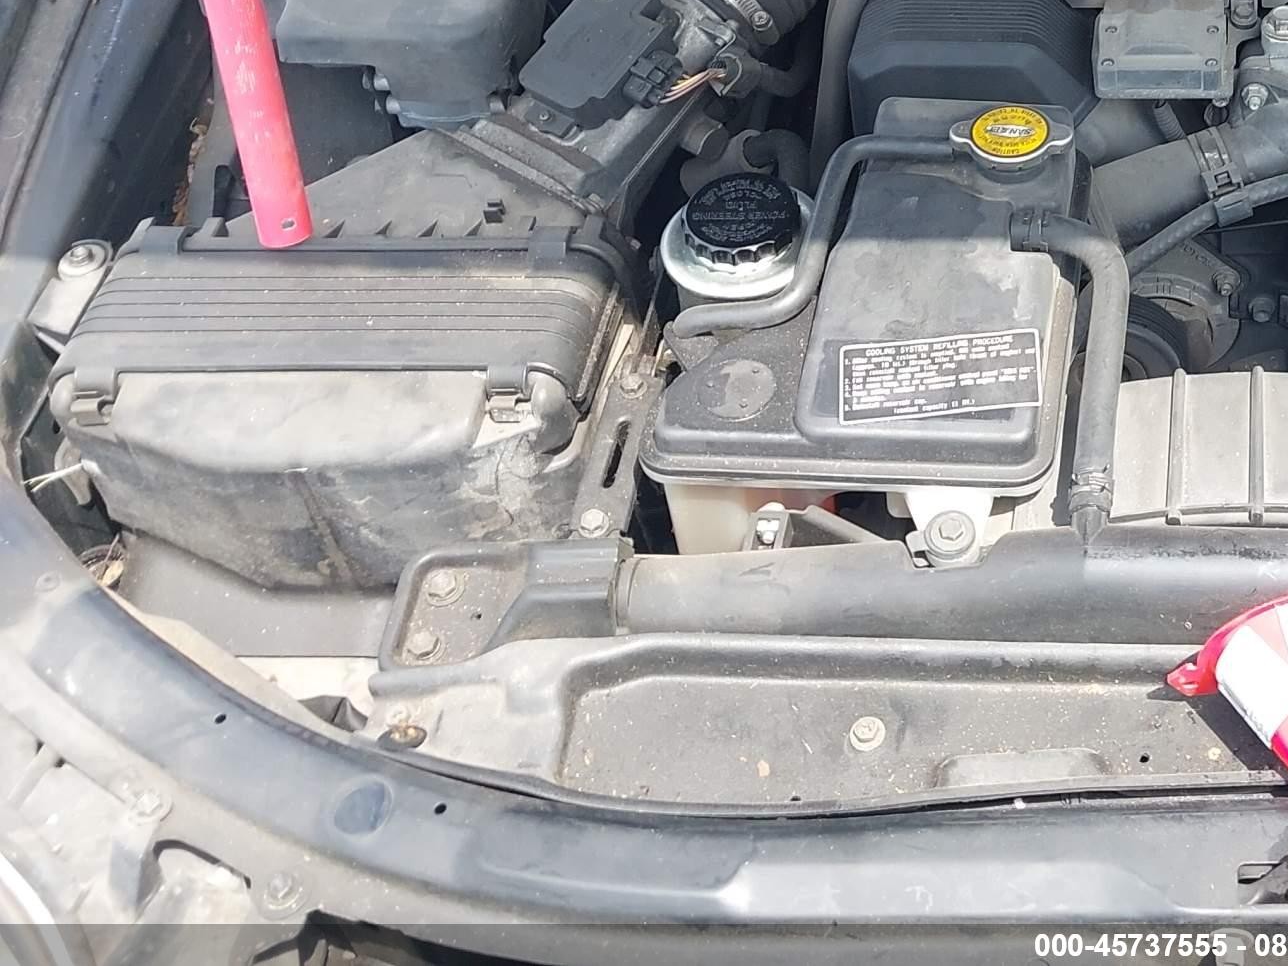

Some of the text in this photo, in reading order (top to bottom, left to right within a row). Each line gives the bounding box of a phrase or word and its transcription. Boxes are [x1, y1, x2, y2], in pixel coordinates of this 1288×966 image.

[692, 210, 786, 221] POWER STEERING
[865, 347, 896, 357] COOLING
[900, 344, 929, 354] SYSTEM
[972, 335, 1014, 346] PROCEDURE
